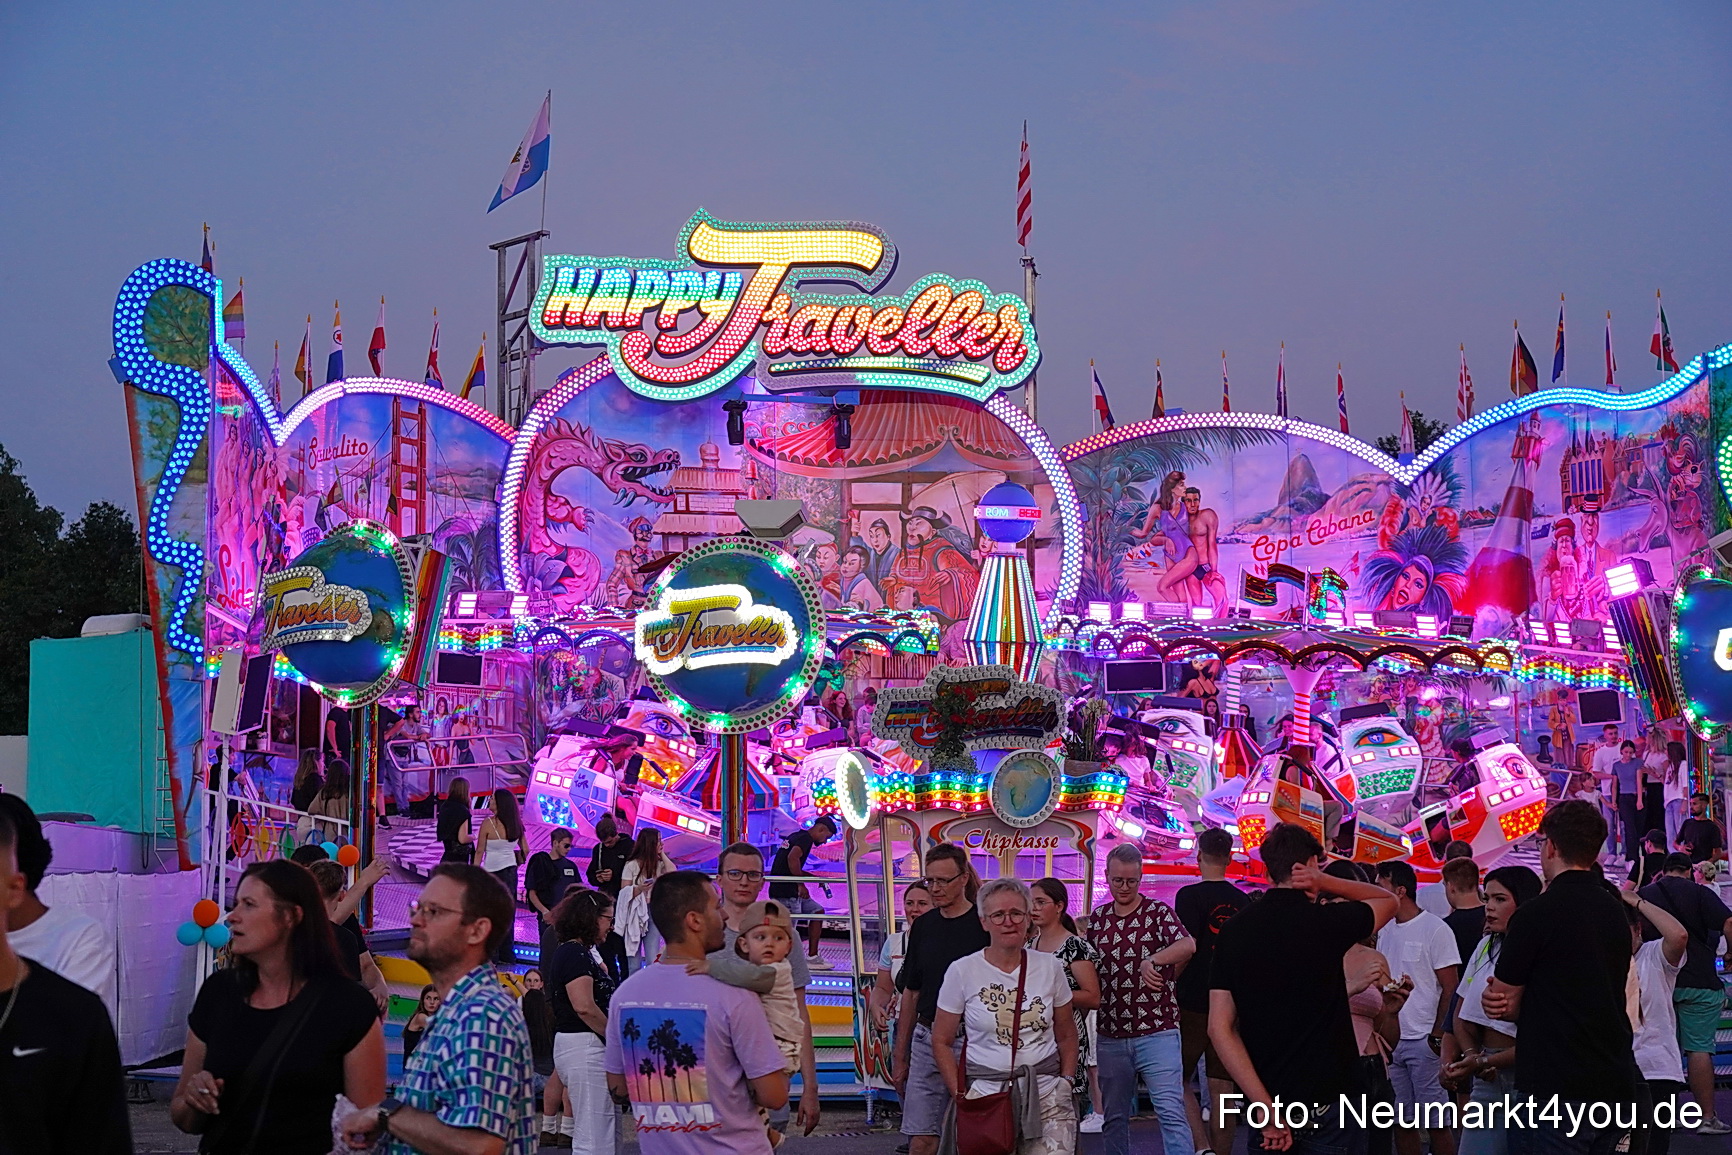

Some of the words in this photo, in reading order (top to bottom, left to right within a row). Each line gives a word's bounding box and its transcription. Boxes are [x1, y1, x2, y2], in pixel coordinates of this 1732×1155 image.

[542, 264, 743, 354] HAPPY
[621, 221, 1028, 383] Traveller
[985, 507, 1009, 517] ROM
[1250, 535, 1303, 563] Copa
[1305, 509, 1376, 546] Cabana
[265, 576, 363, 640] Traveller
[653, 594, 789, 662] Traveller
[964, 828, 1059, 858] Chipkasse
